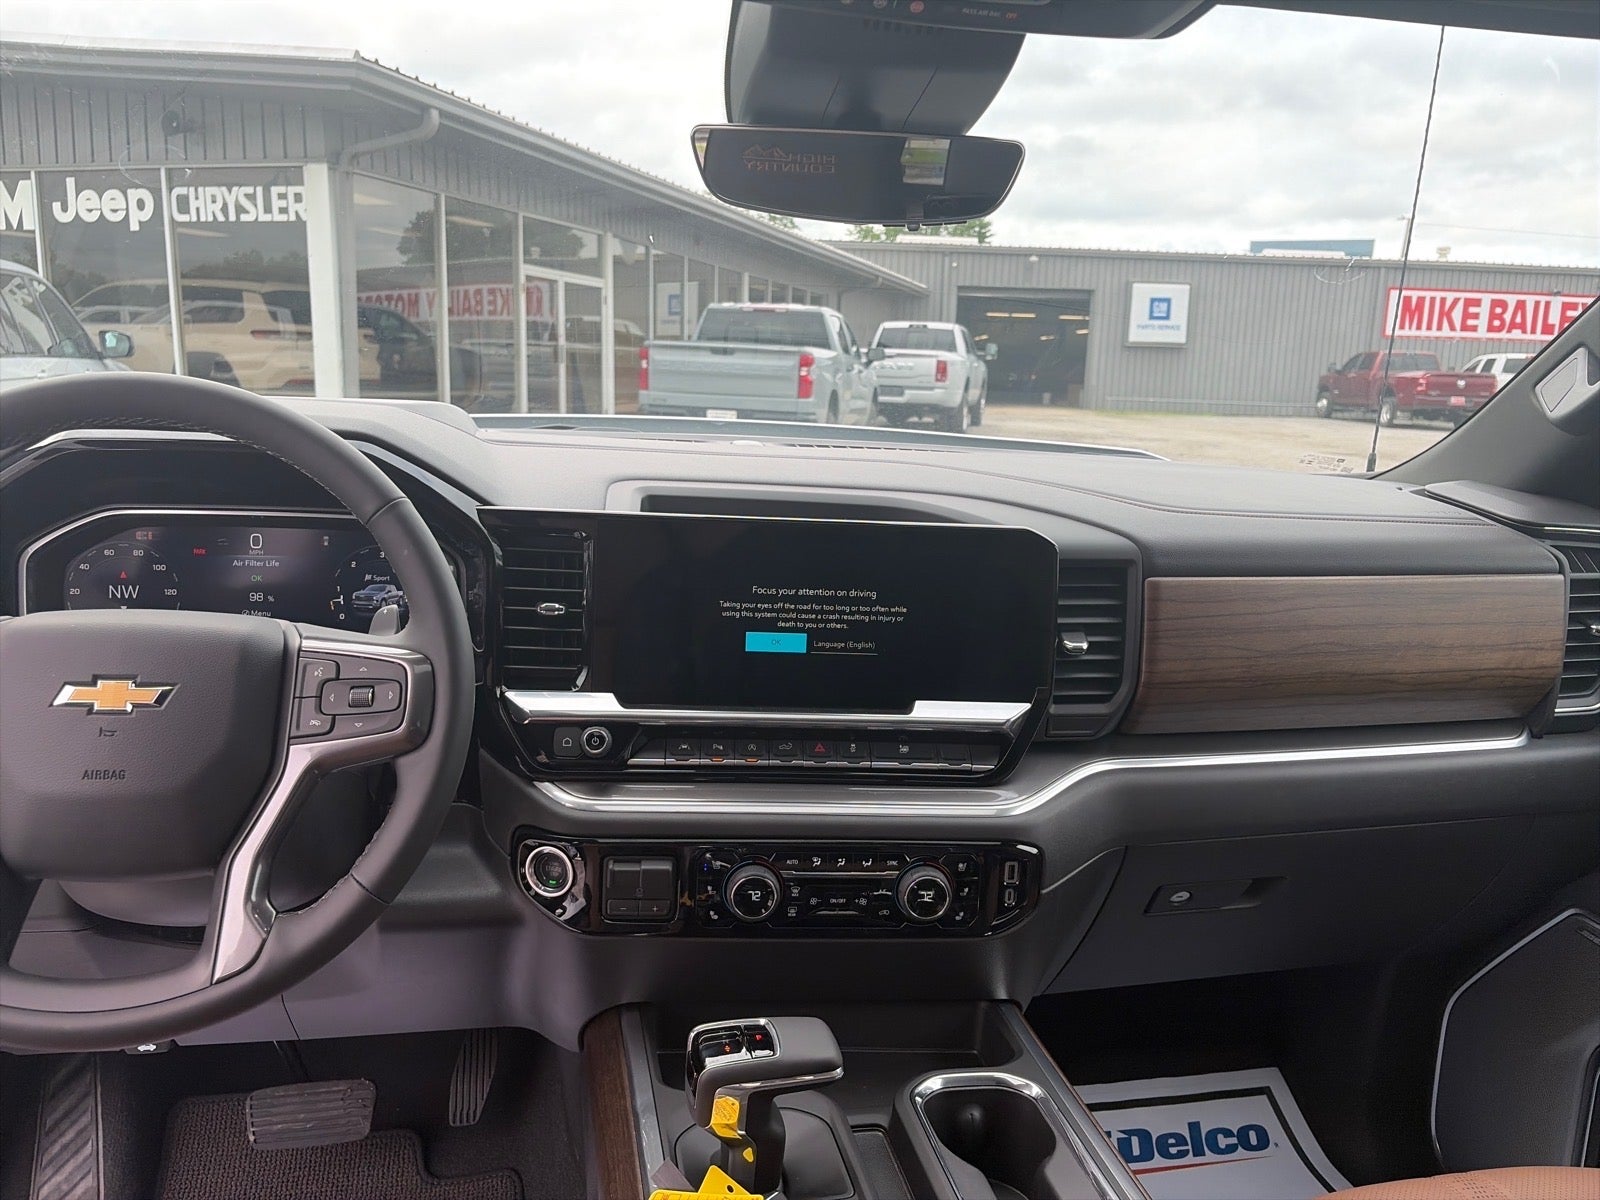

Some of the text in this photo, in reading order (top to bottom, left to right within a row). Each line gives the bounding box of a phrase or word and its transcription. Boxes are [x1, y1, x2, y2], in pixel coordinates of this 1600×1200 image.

[52, 177, 154, 231] Jeep
[170, 186, 308, 222] CHRYSLER
[1398, 295, 1591, 336] MIKE BAILE
[250, 533, 263, 549] 0
[133, 549, 144, 557] 80
[232, 559, 280, 567] Air Filter Life
[373, 574, 390, 582] Sport
[108, 585, 140, 599] NW
[164, 588, 178, 596] 120
[249, 592, 264, 602] 98
[752, 585, 777, 594] Focus
[778, 587, 796, 597] your
[798, 587, 835, 597] attention
[849, 588, 877, 600] driving
[719, 600, 741, 609] Taking
[835, 604, 850, 613] long
[251, 609, 272, 617] Menu
[721, 610, 740, 619] using
[841, 613, 869, 622] resulting
[877, 615, 896, 623] injury
[813, 640, 876, 650] Language (English)
[81, 769, 127, 780] AIRBAG
[747, 890, 761, 901] 72
[1104, 1120, 1271, 1164] Delco
